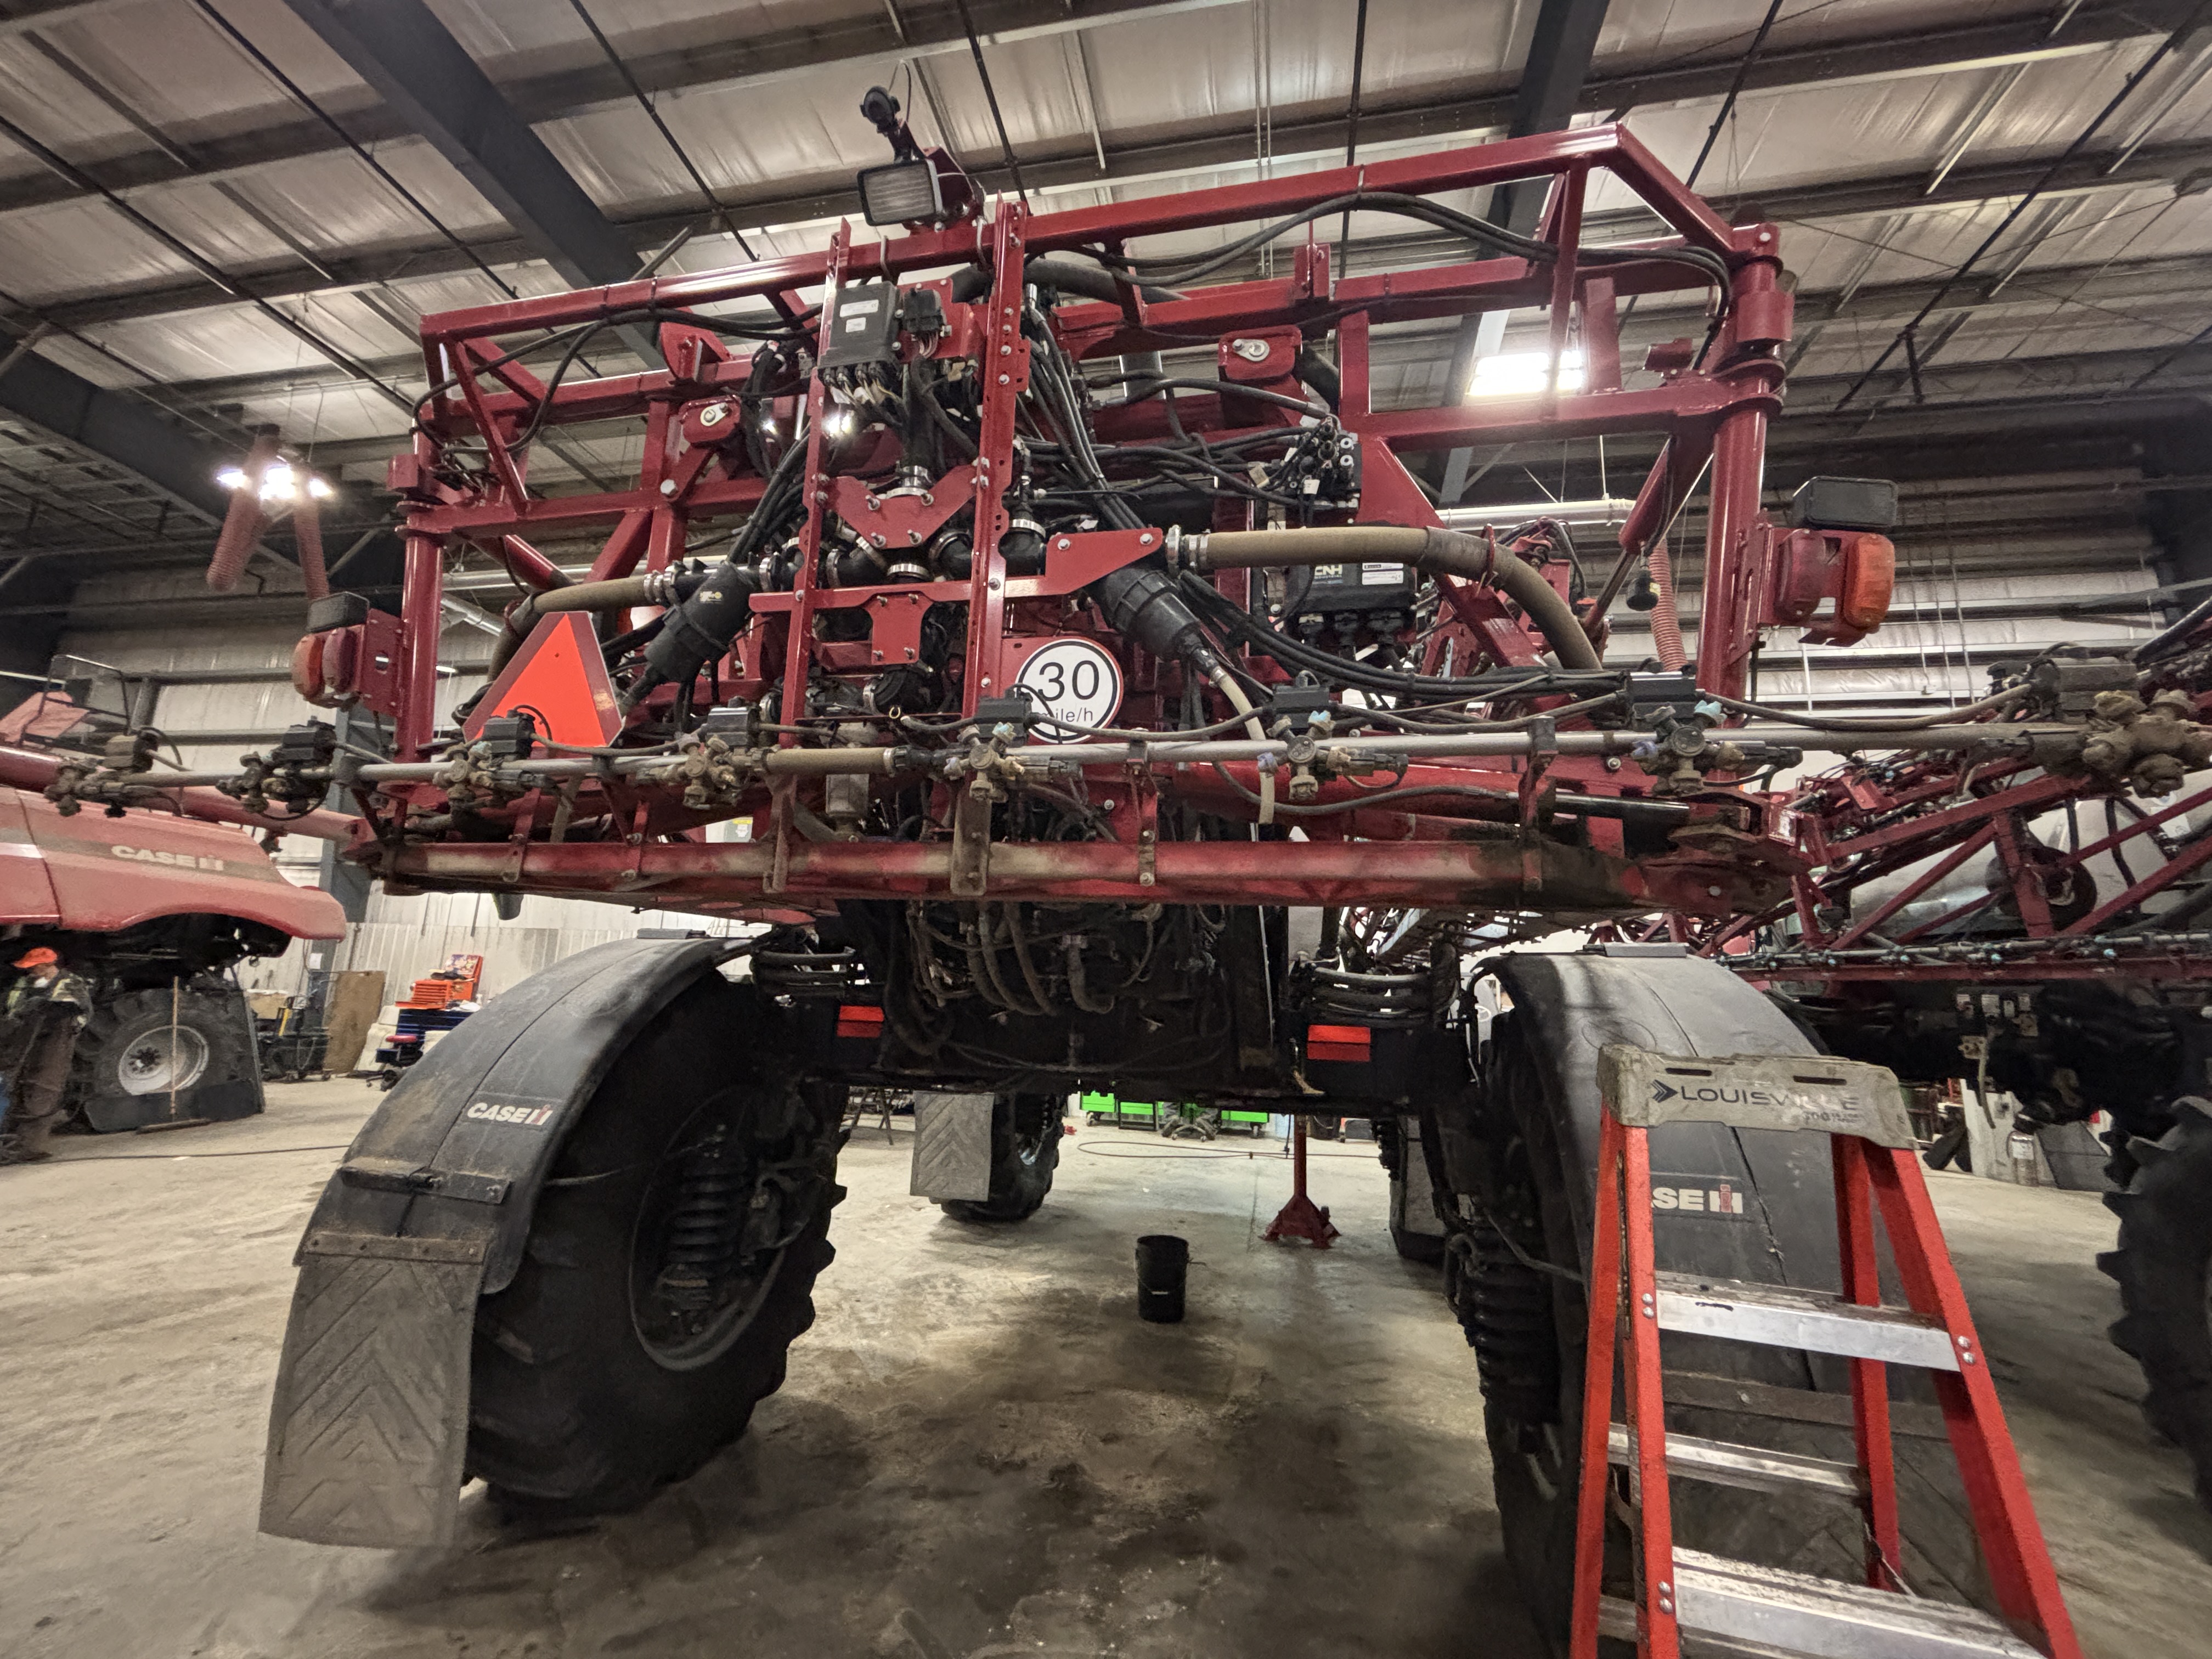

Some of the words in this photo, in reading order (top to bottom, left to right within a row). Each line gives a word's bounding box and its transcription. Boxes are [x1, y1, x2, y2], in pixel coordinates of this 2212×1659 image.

[1314, 565, 1342, 575] CNH
[1037, 660, 1099, 702] 30
[1041, 707, 1093, 723] ile/h
[111, 845, 196, 868] CASE
[467, 1102, 532, 1123] CASE
